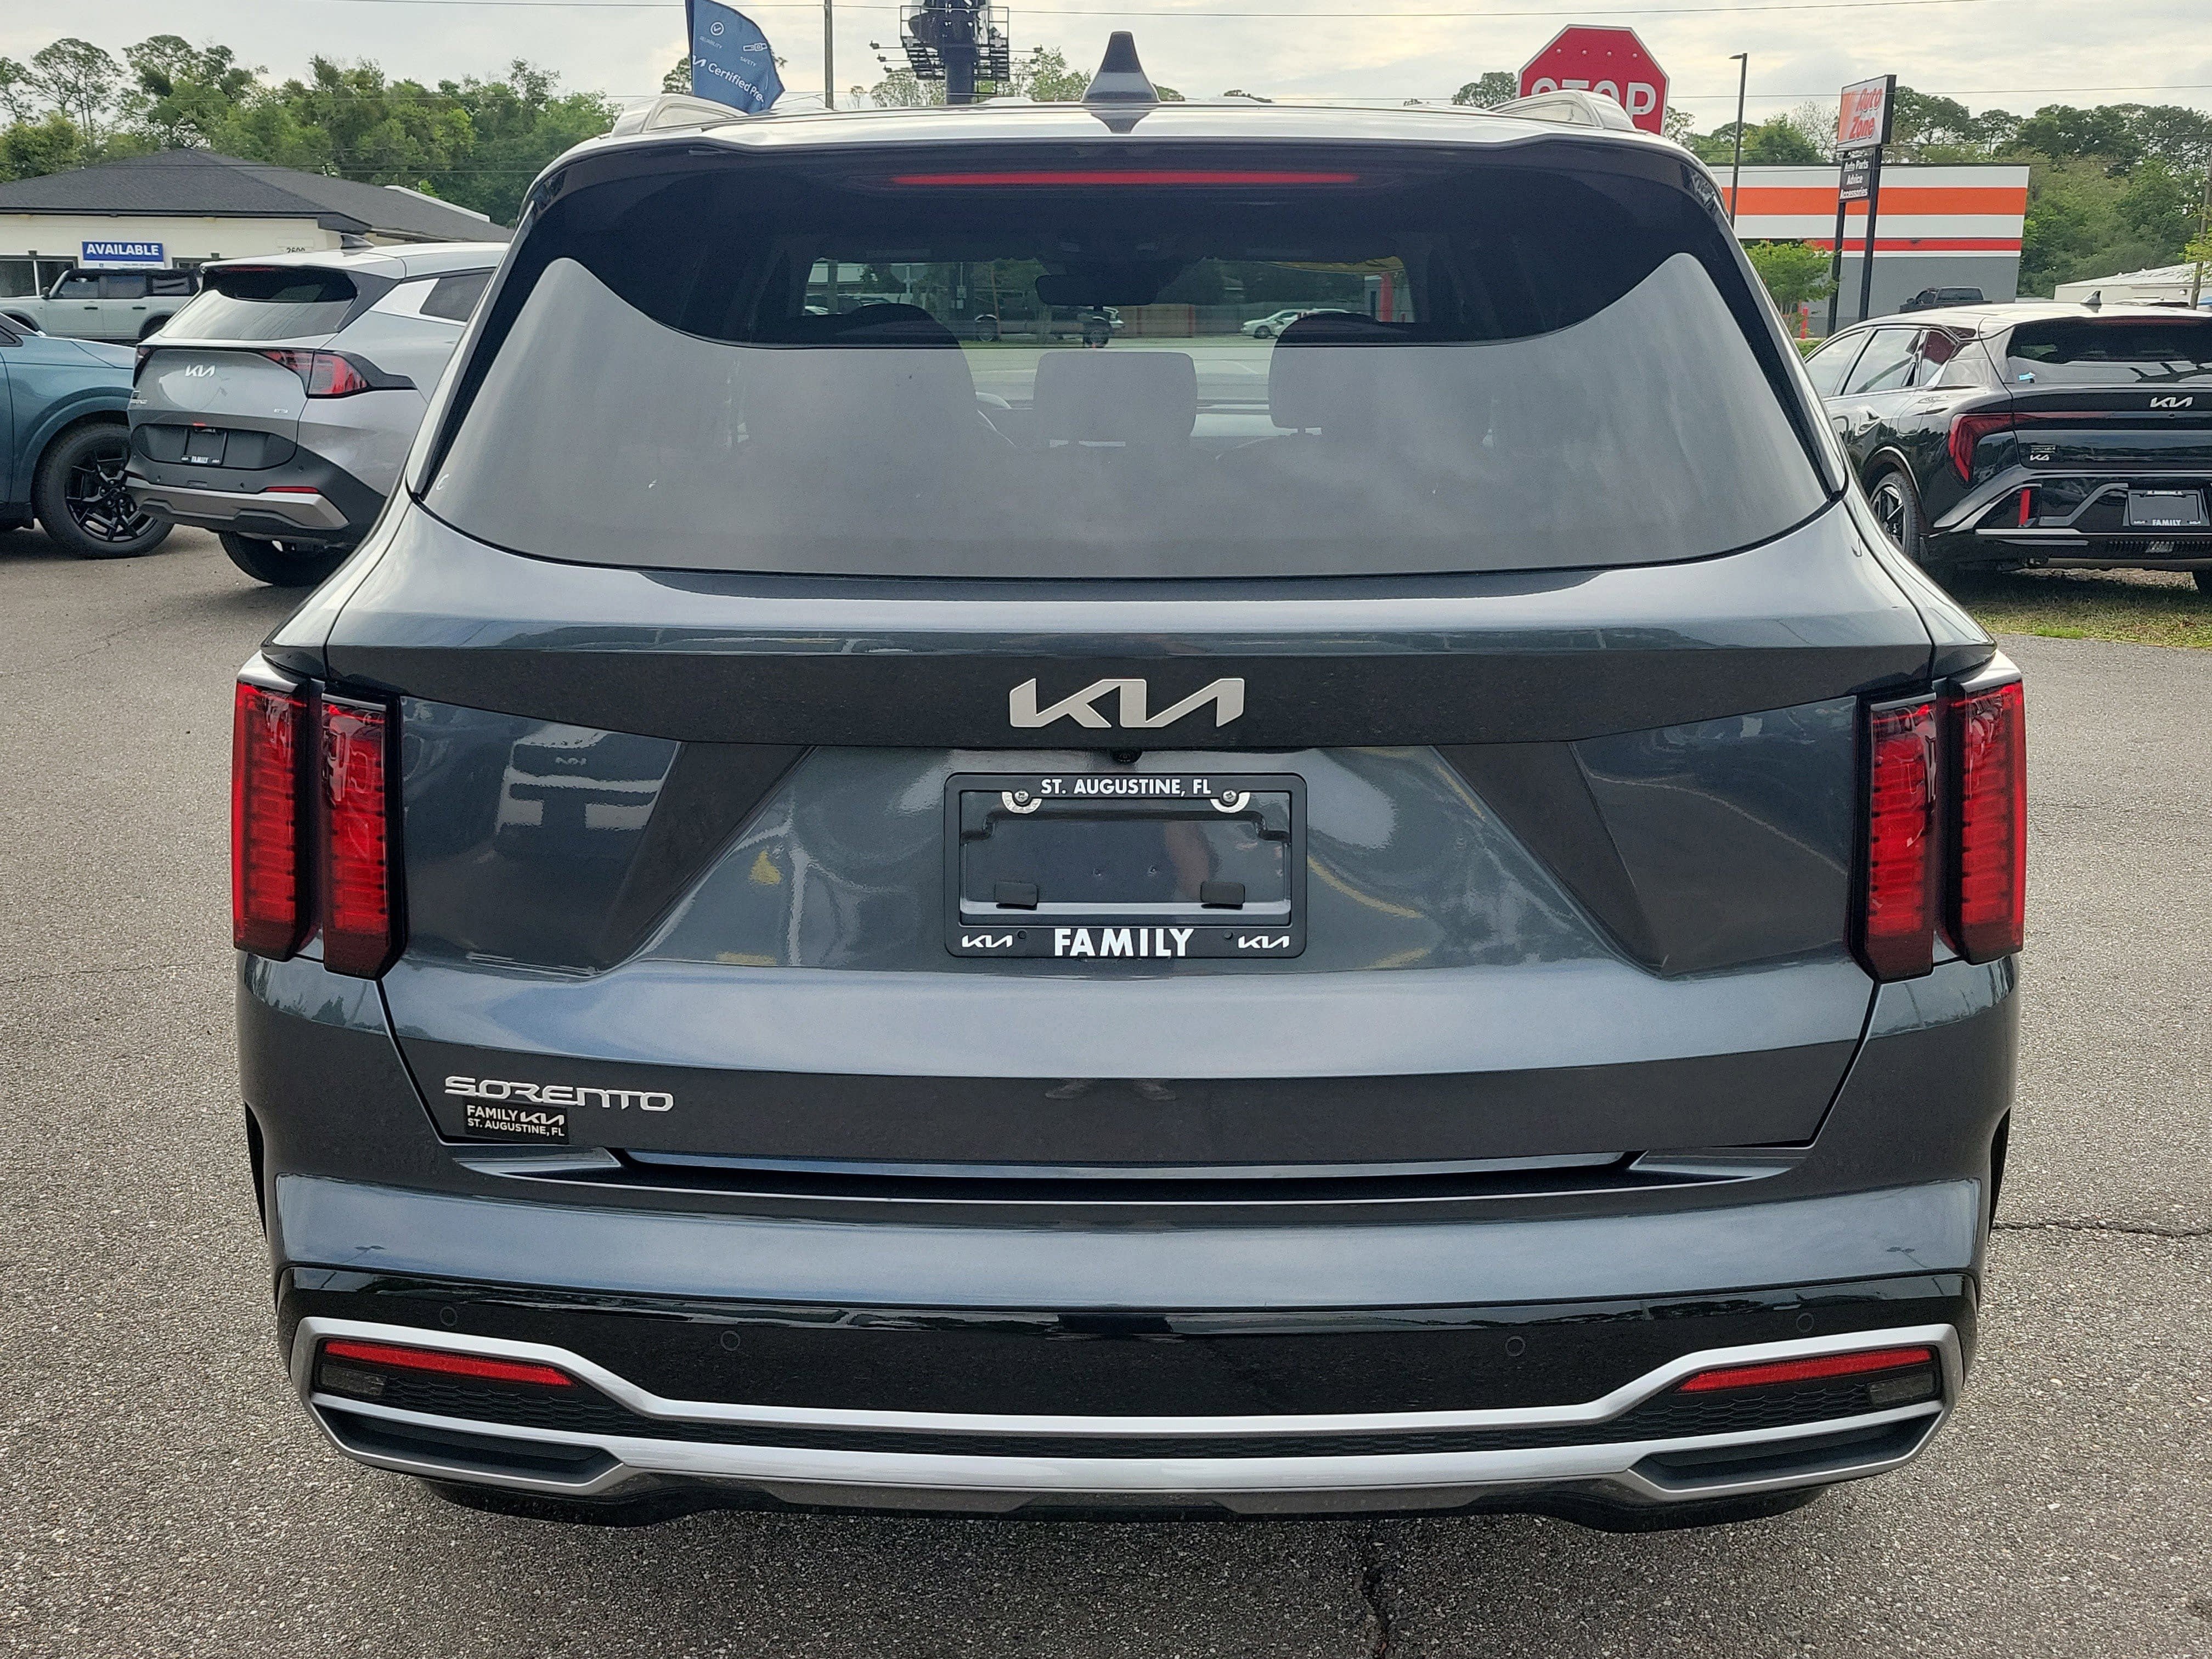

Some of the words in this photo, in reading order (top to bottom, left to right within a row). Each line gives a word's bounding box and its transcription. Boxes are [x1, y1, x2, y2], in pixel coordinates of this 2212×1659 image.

[740, 56, 757, 67] SAFETY
[708, 63, 752, 92] Certified
[1855, 88, 1883, 112] Auto
[1848, 115, 1875, 139] Zone
[1855, 159, 1869, 170] Parts
[86, 244, 160, 256] AVAILABLE
[185, 364, 216, 377] KIA
[2150, 397, 2193, 407] KIA
[1009, 678, 1245, 728] KIA
[1041, 779, 1066, 794] ST.
[1073, 778, 1186, 797] AUGUSTINE,
[1192, 779, 1211, 795] FL
[961, 935, 1013, 949] KIA
[1054, 928, 1194, 957] FAMILY
[1238, 935, 1289, 949] KIA
[444, 1075, 674, 1112] SORENTO
[466, 1105, 520, 1122] FAMILY
[520, 1111, 565, 1126] KIA
[467, 1118, 483, 1129] ST.
[485, 1119, 550, 1136] AUGUSTINE,
[551, 1127, 565, 1137] FL
